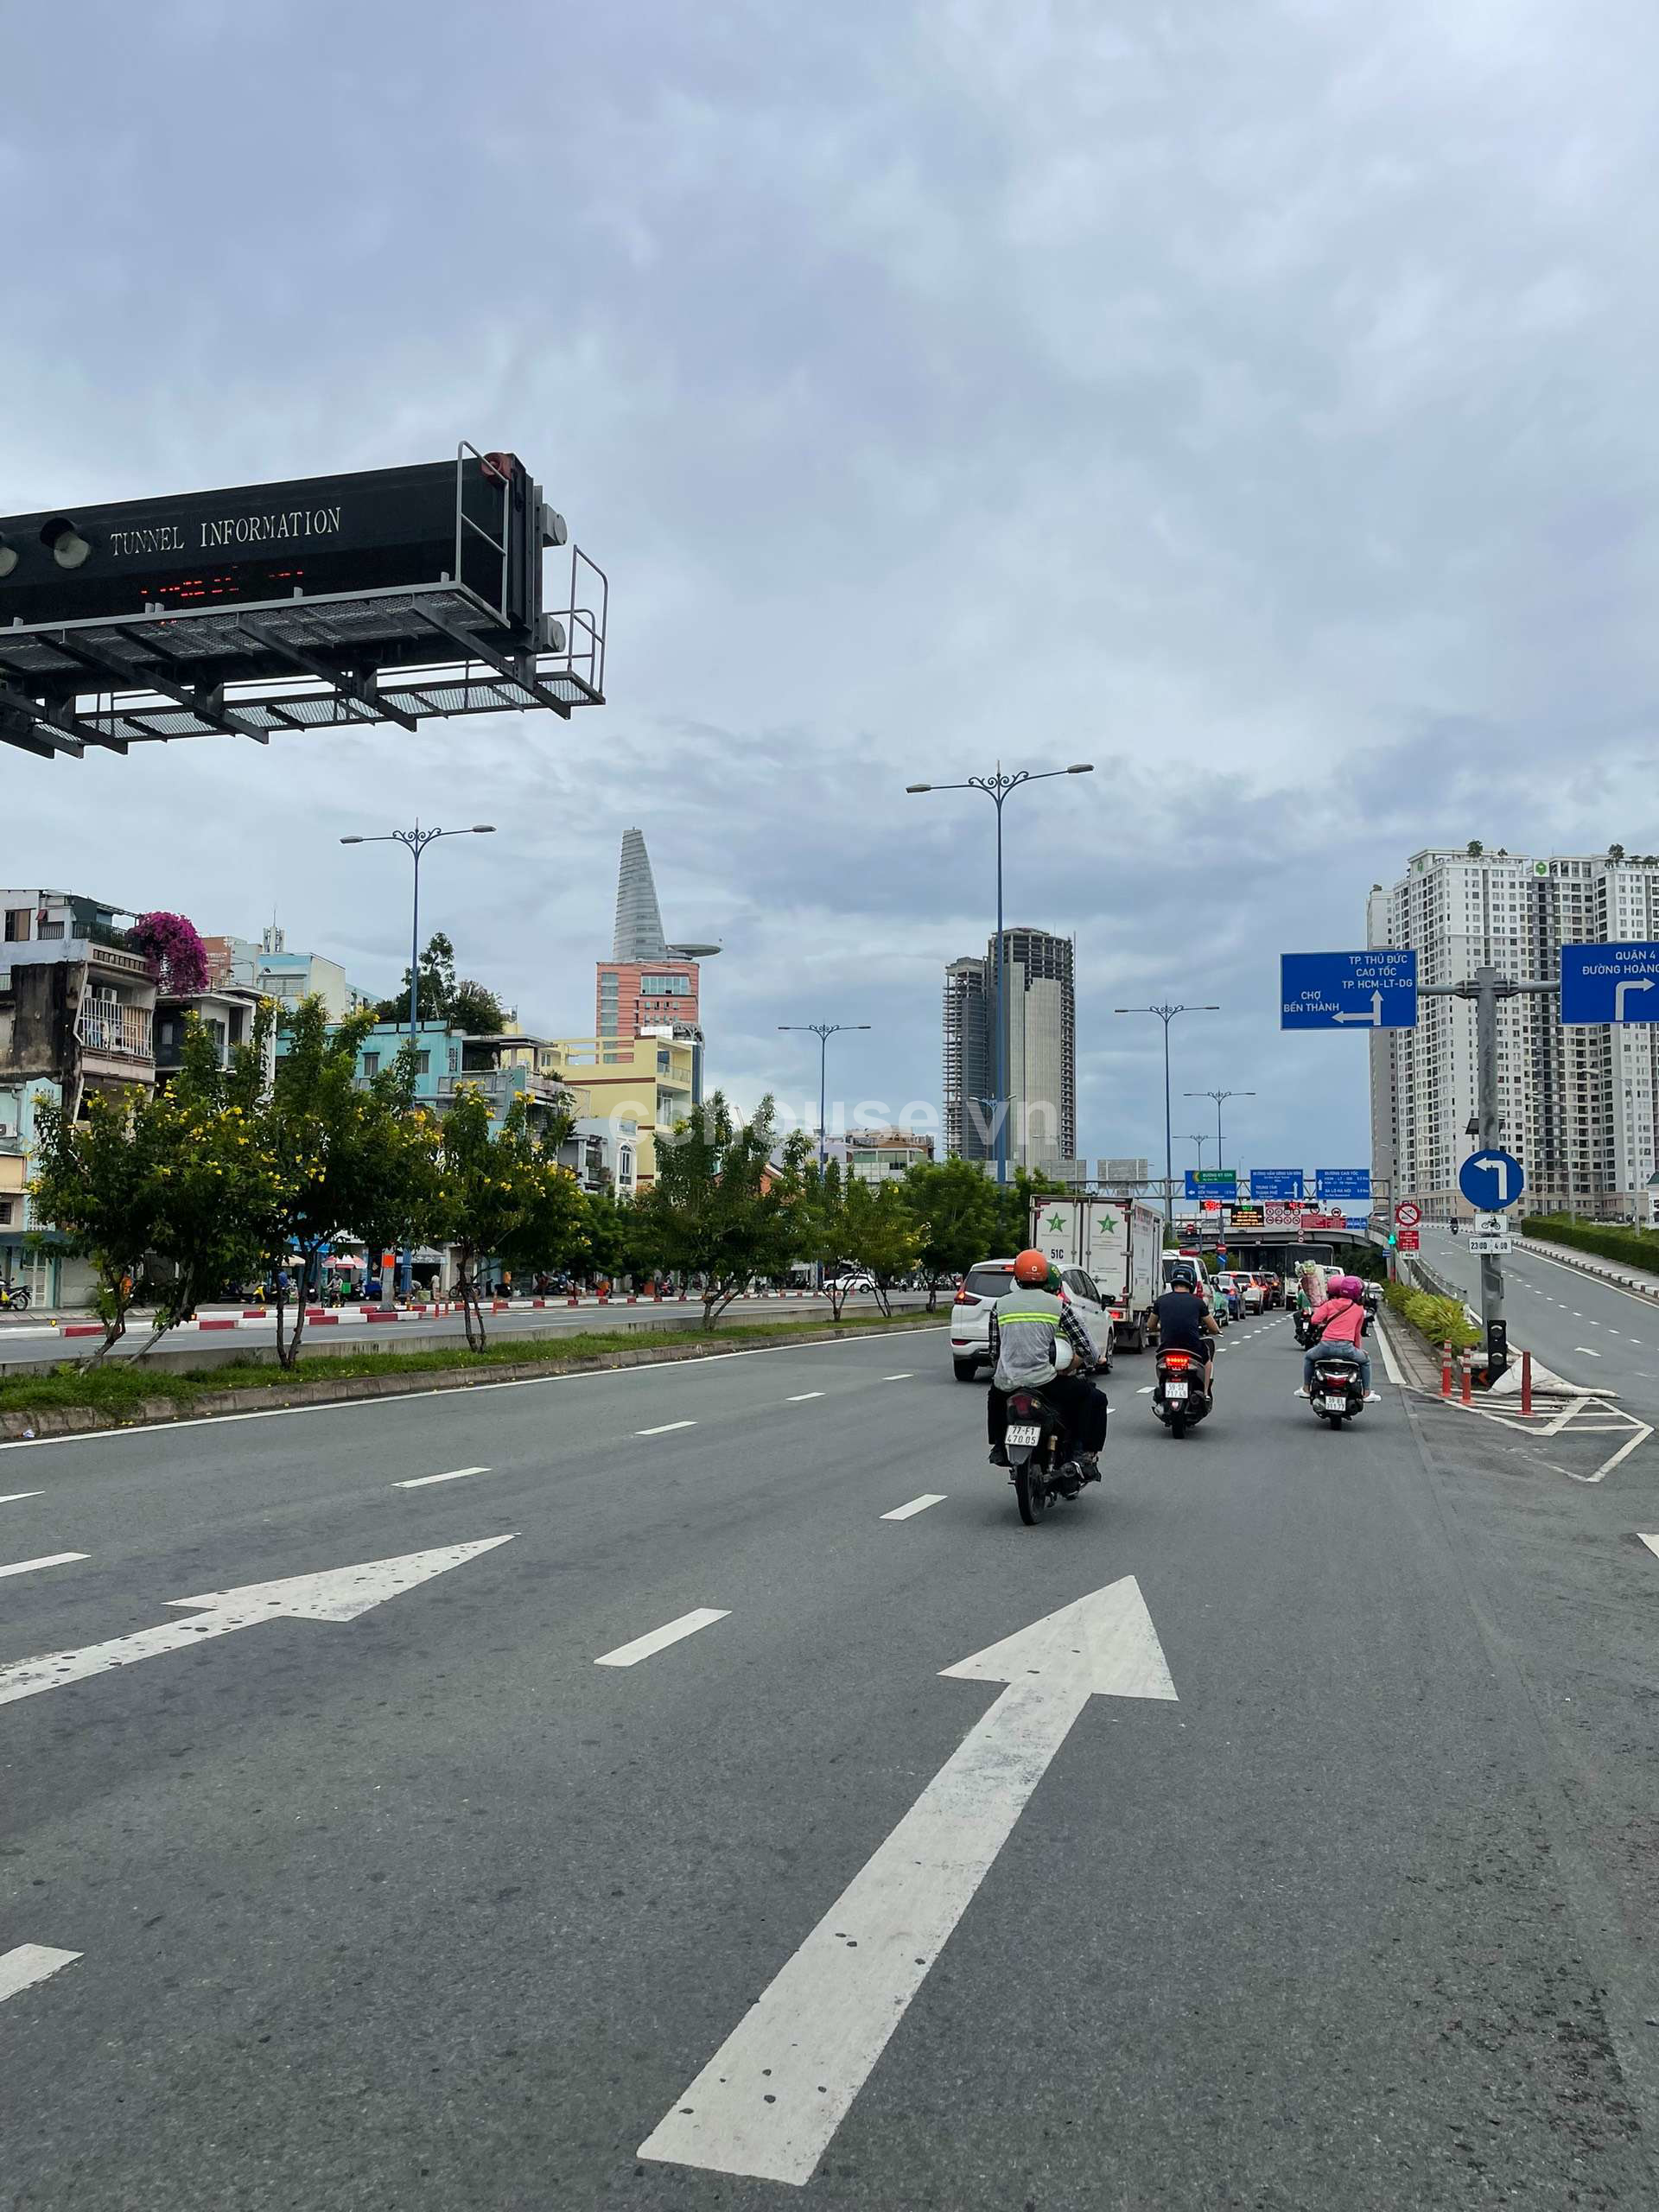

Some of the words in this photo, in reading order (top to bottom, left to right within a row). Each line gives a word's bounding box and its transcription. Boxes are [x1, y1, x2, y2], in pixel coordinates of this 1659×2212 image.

[110, 525, 185, 557] TUNNEL
[200, 506, 341, 548] INFORMATION
[1348, 956, 1363, 964] TP.
[1364, 953, 1383, 964] THỦ
[1386, 952, 1408, 964] ĐỨC
[1615, 949, 1646, 962] QUẬN
[1649, 950, 1656, 960] 4
[1356, 968, 1376, 977] CAO
[1377, 964, 1397, 976] TỐC
[1582, 963, 1621, 976] ĐƯỜNG
[1342, 980, 1355, 989] TP.
[1357, 978, 1413, 988] HCM-LT-DG
[1300, 990, 1321, 1001] CHỢ
[1283, 1001, 1304, 1013] BẾN
[1306, 1001, 1339, 1012] THÀNH
[1051, 1249, 1064, 1259] 51C
